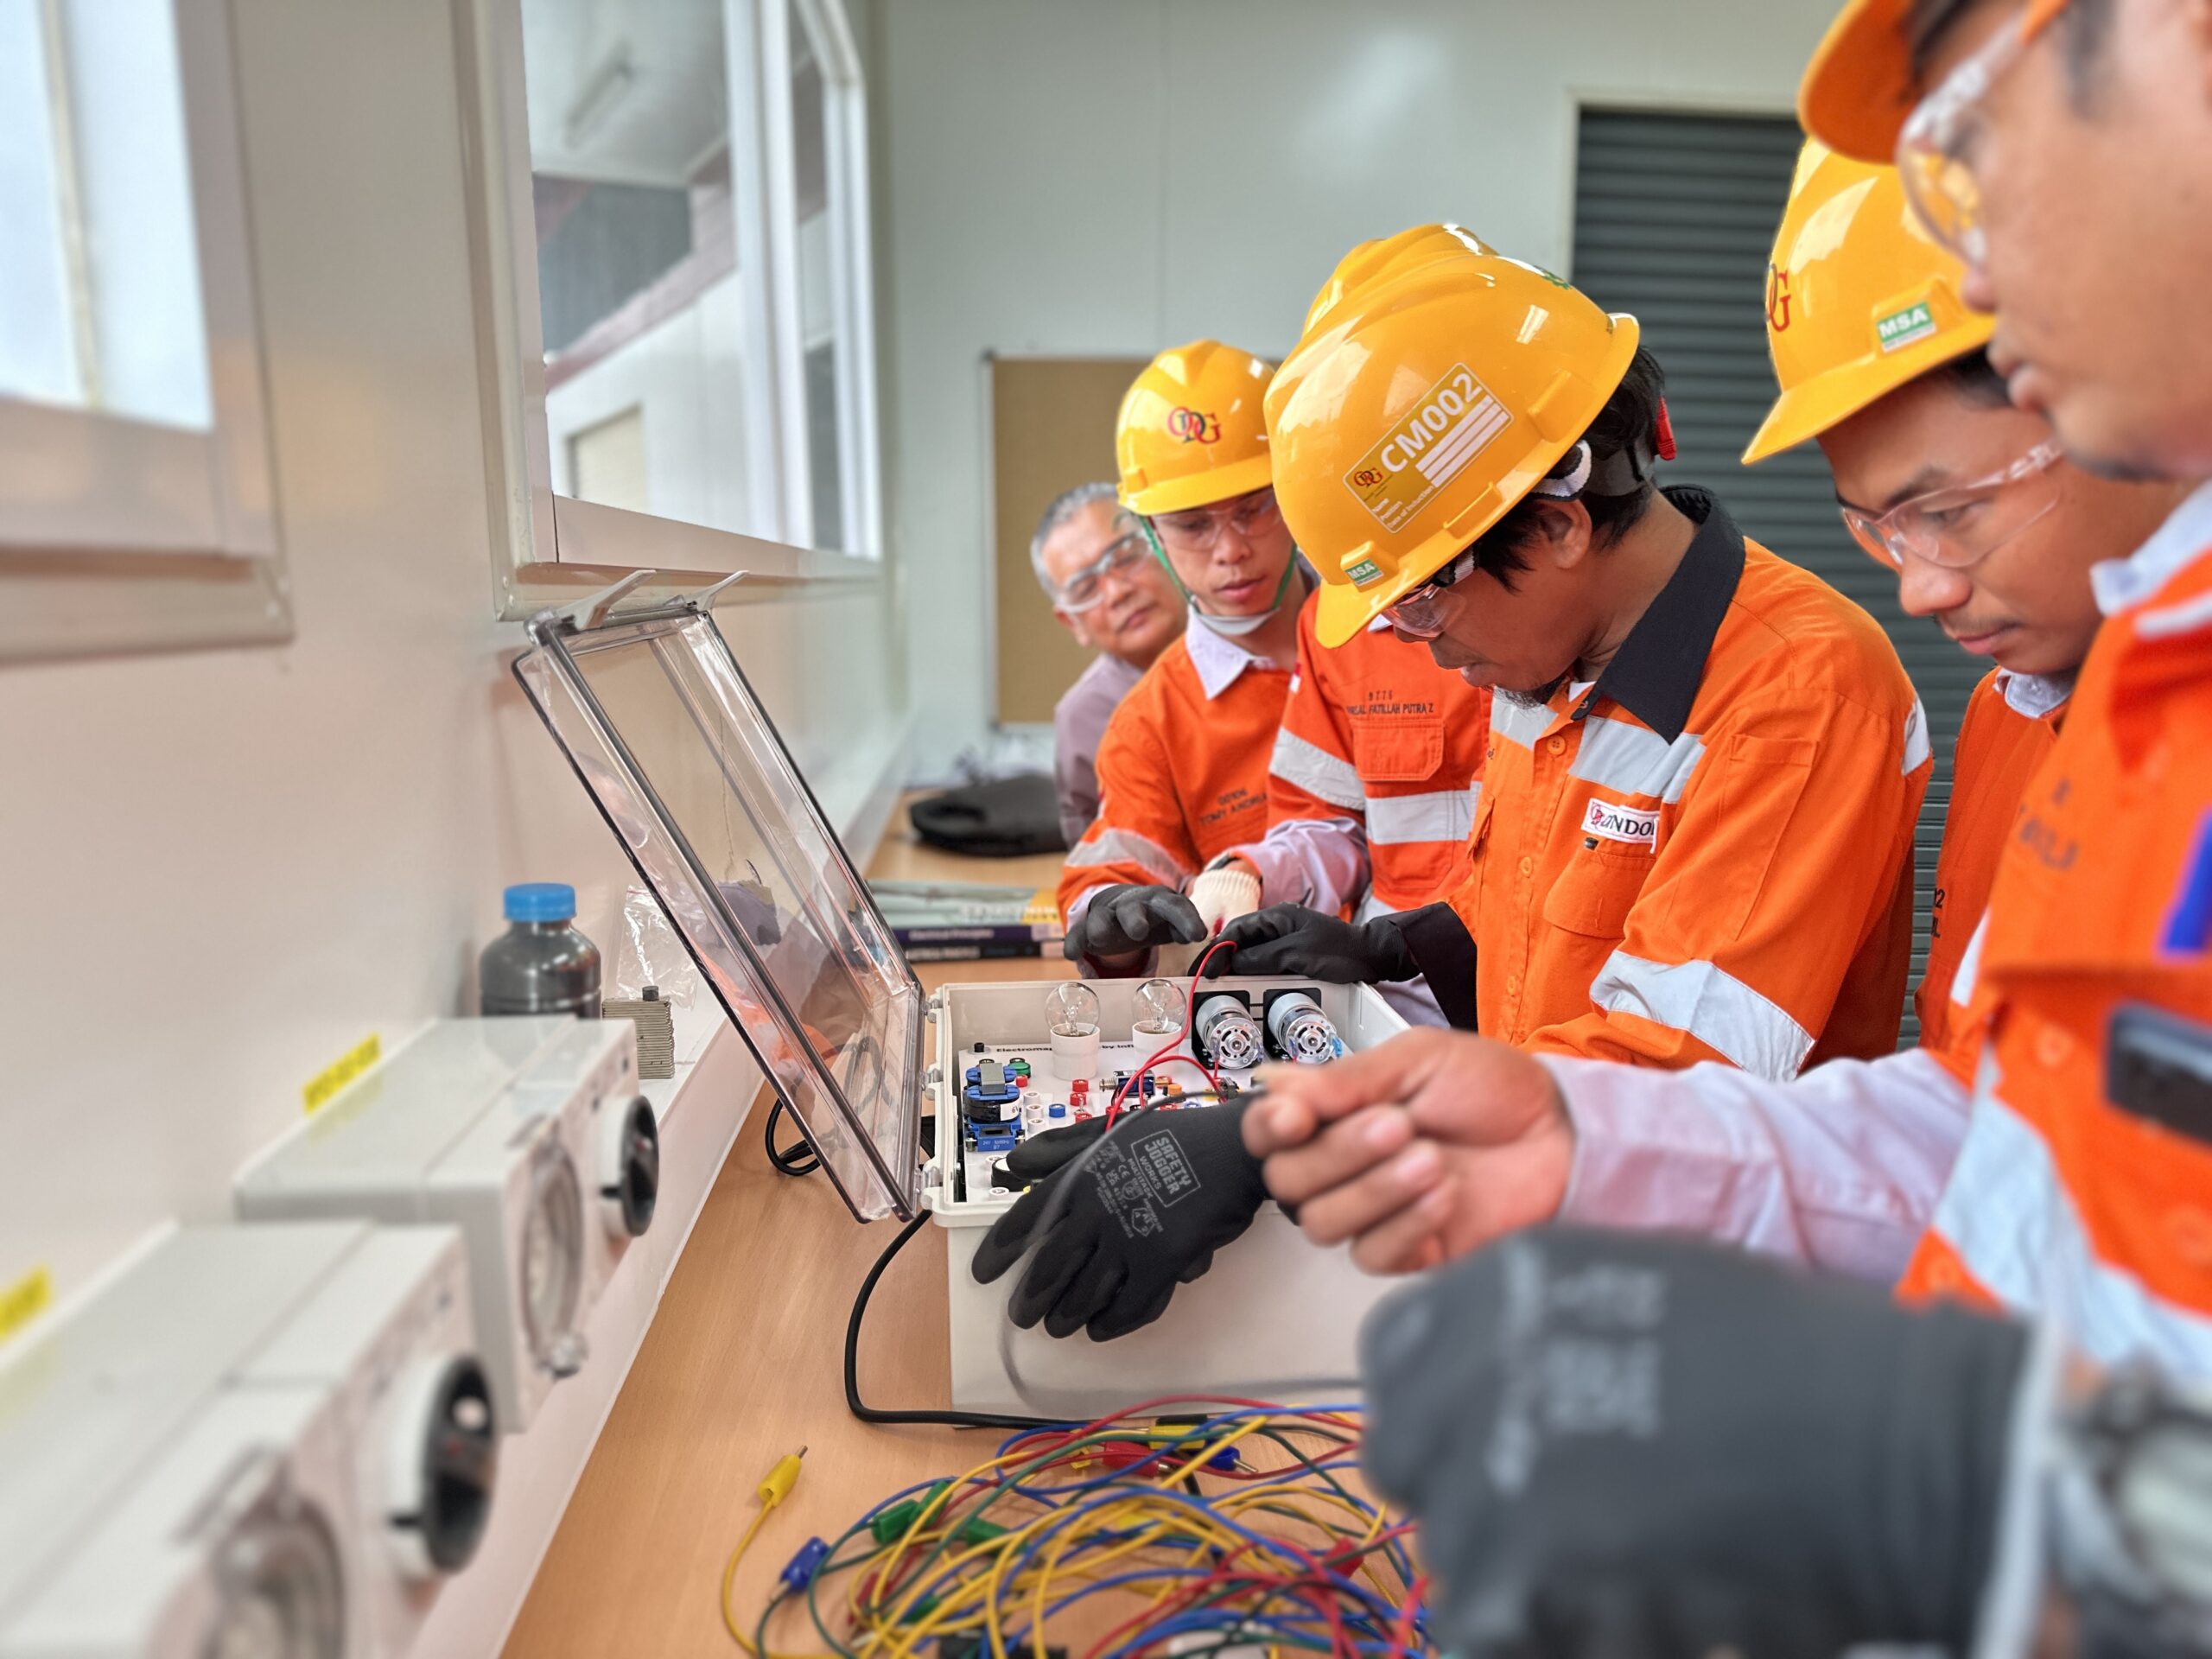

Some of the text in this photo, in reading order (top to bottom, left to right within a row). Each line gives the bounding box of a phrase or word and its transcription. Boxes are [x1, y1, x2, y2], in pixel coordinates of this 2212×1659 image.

[1878, 308, 1929, 339] MSA
[1381, 372, 1484, 473] CM002
[1347, 563, 1376, 579] MSA
[1128, 1158, 1154, 1199] MULTITASK
[1139, 1155, 1162, 1191] WORKS
[1143, 1141, 1180, 1195] JOGGER
[1156, 1136, 1192, 1186] SAFETY
